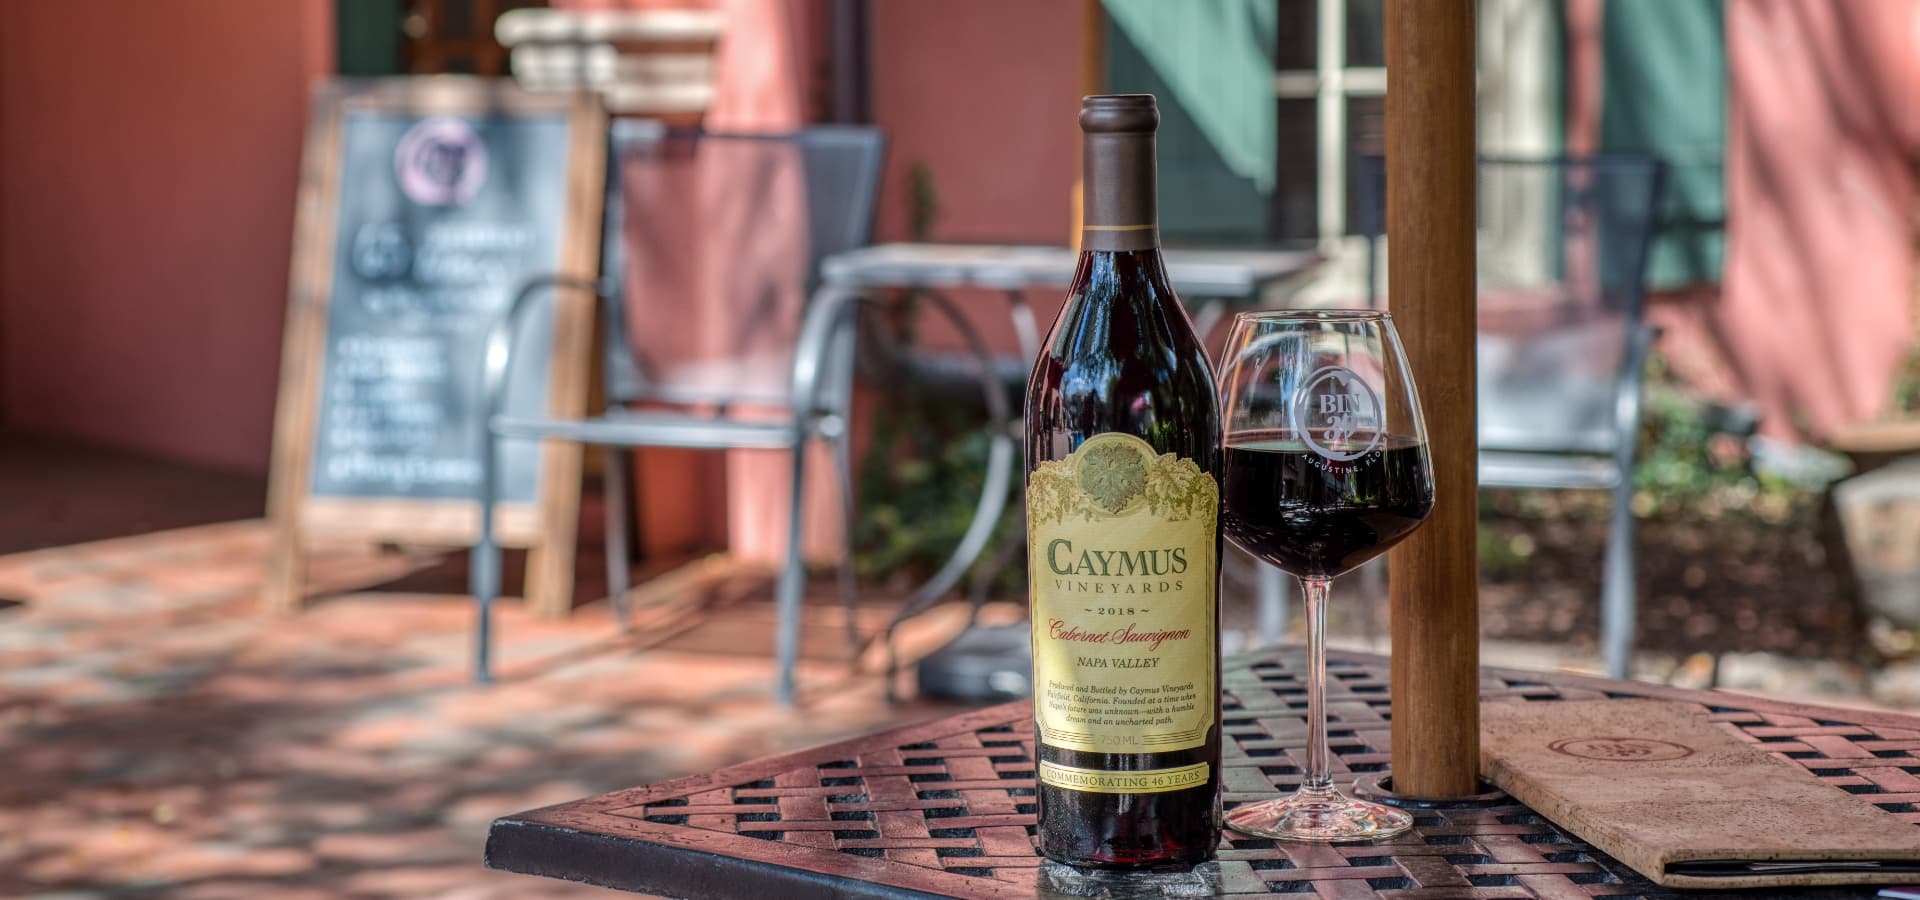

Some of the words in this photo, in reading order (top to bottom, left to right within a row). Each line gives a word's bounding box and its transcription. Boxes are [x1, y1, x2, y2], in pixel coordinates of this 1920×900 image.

[1320, 393, 1360, 413] BIN
[1055, 579, 1183, 593] VINEYARDS
[1097, 606, 1135, 615] 2018
[1048, 618, 1110, 643] Cabernet
[1111, 622, 1191, 651] Sauvignon
[1077, 656, 1107, 667] NAPA
[1112, 657, 1160, 668] VALLEY
[1076, 685, 1088, 693] and
[1090, 685, 1116, 694] Bottled
[1119, 686, 1127, 696] by
[1130, 686, 1160, 695] Caymus
[1162, 682, 1193, 693] Vineyards
[1048, 689, 1070, 700] Fairfld,
[1113, 696, 1146, 704] Founded
[1181, 693, 1196, 701] when
[1088, 717, 1102, 725] and
[1115, 717, 1153, 726] uncharted
[1123, 736, 1138, 745] ML
[1047, 769, 1147, 787] COMMEMORATING
[1152, 777, 1163, 786] 46
[1168, 770, 1200, 784] YEARS
